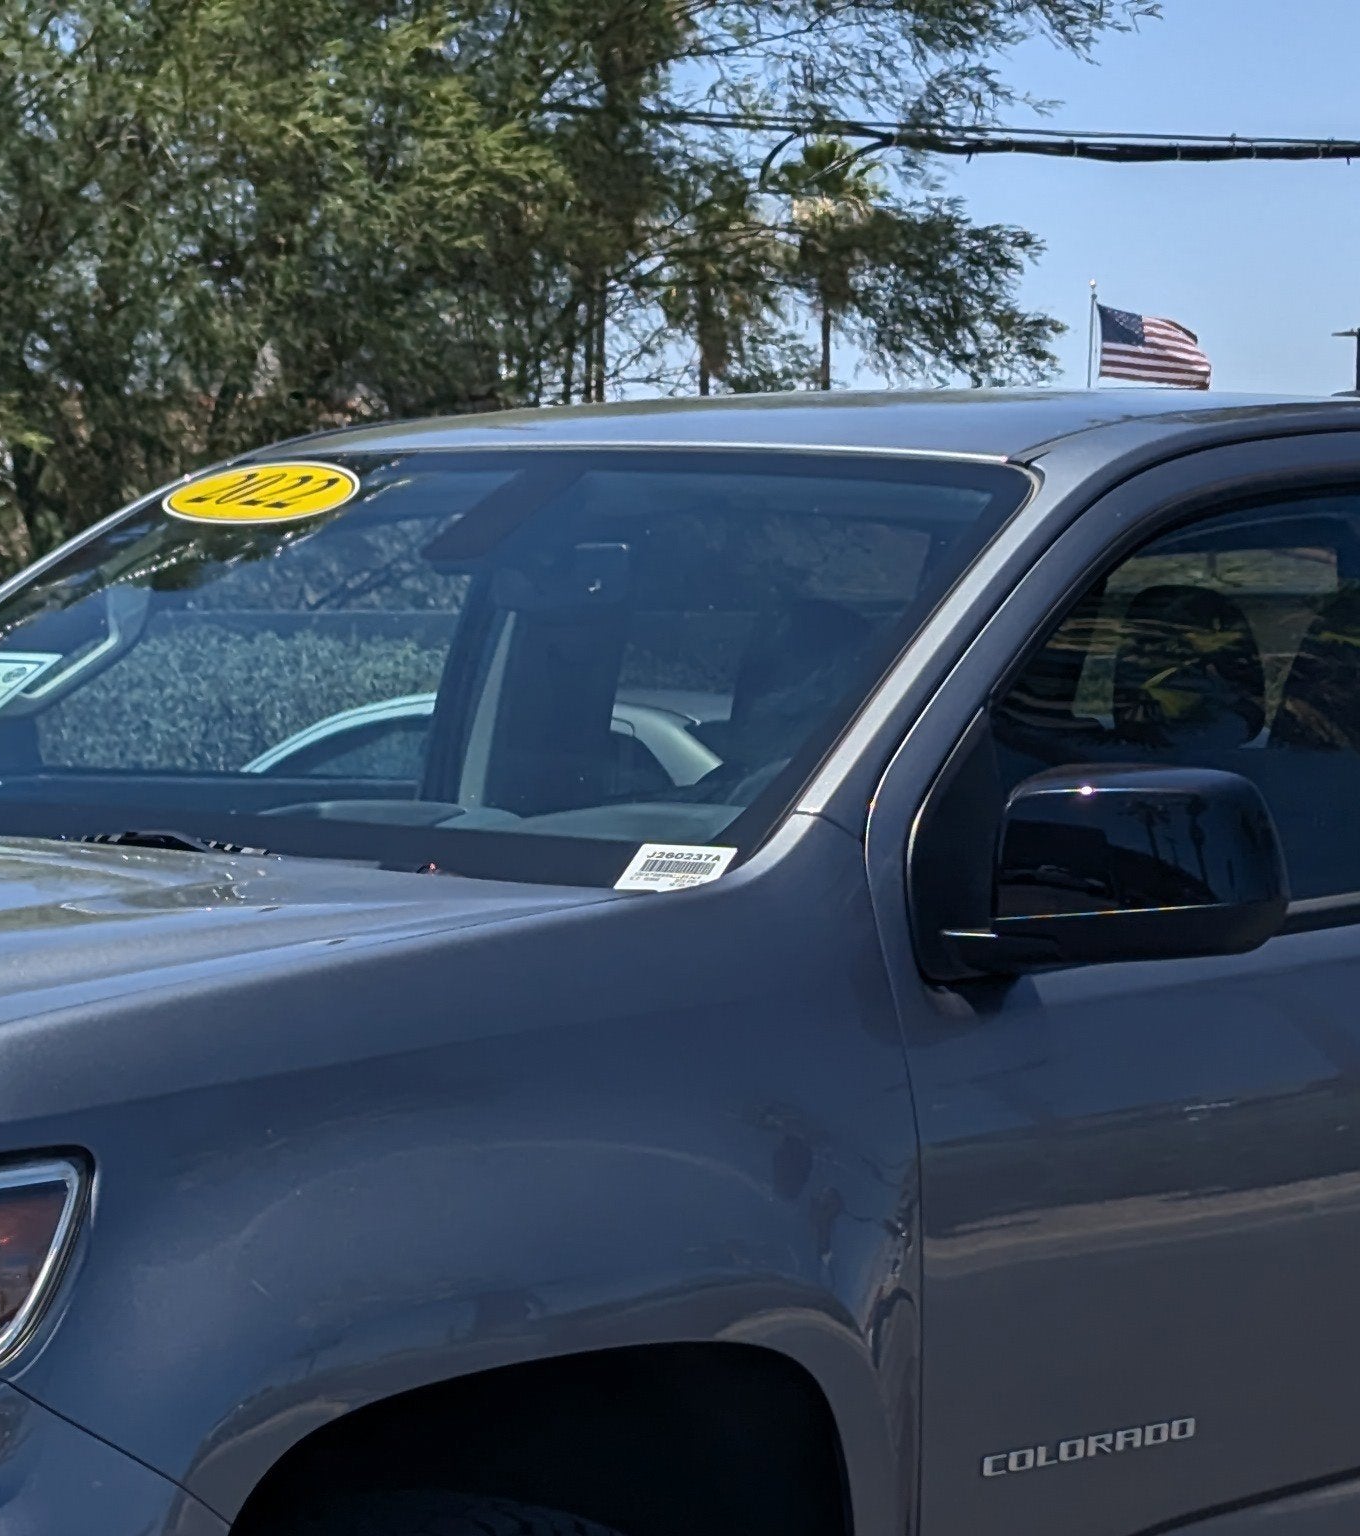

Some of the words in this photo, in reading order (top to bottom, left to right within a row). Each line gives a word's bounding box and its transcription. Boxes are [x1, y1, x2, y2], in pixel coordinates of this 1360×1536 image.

[186, 472, 340, 510] 2022
[646, 850, 722, 862] J260237A
[982, 1417, 1196, 1477] COLORADO
